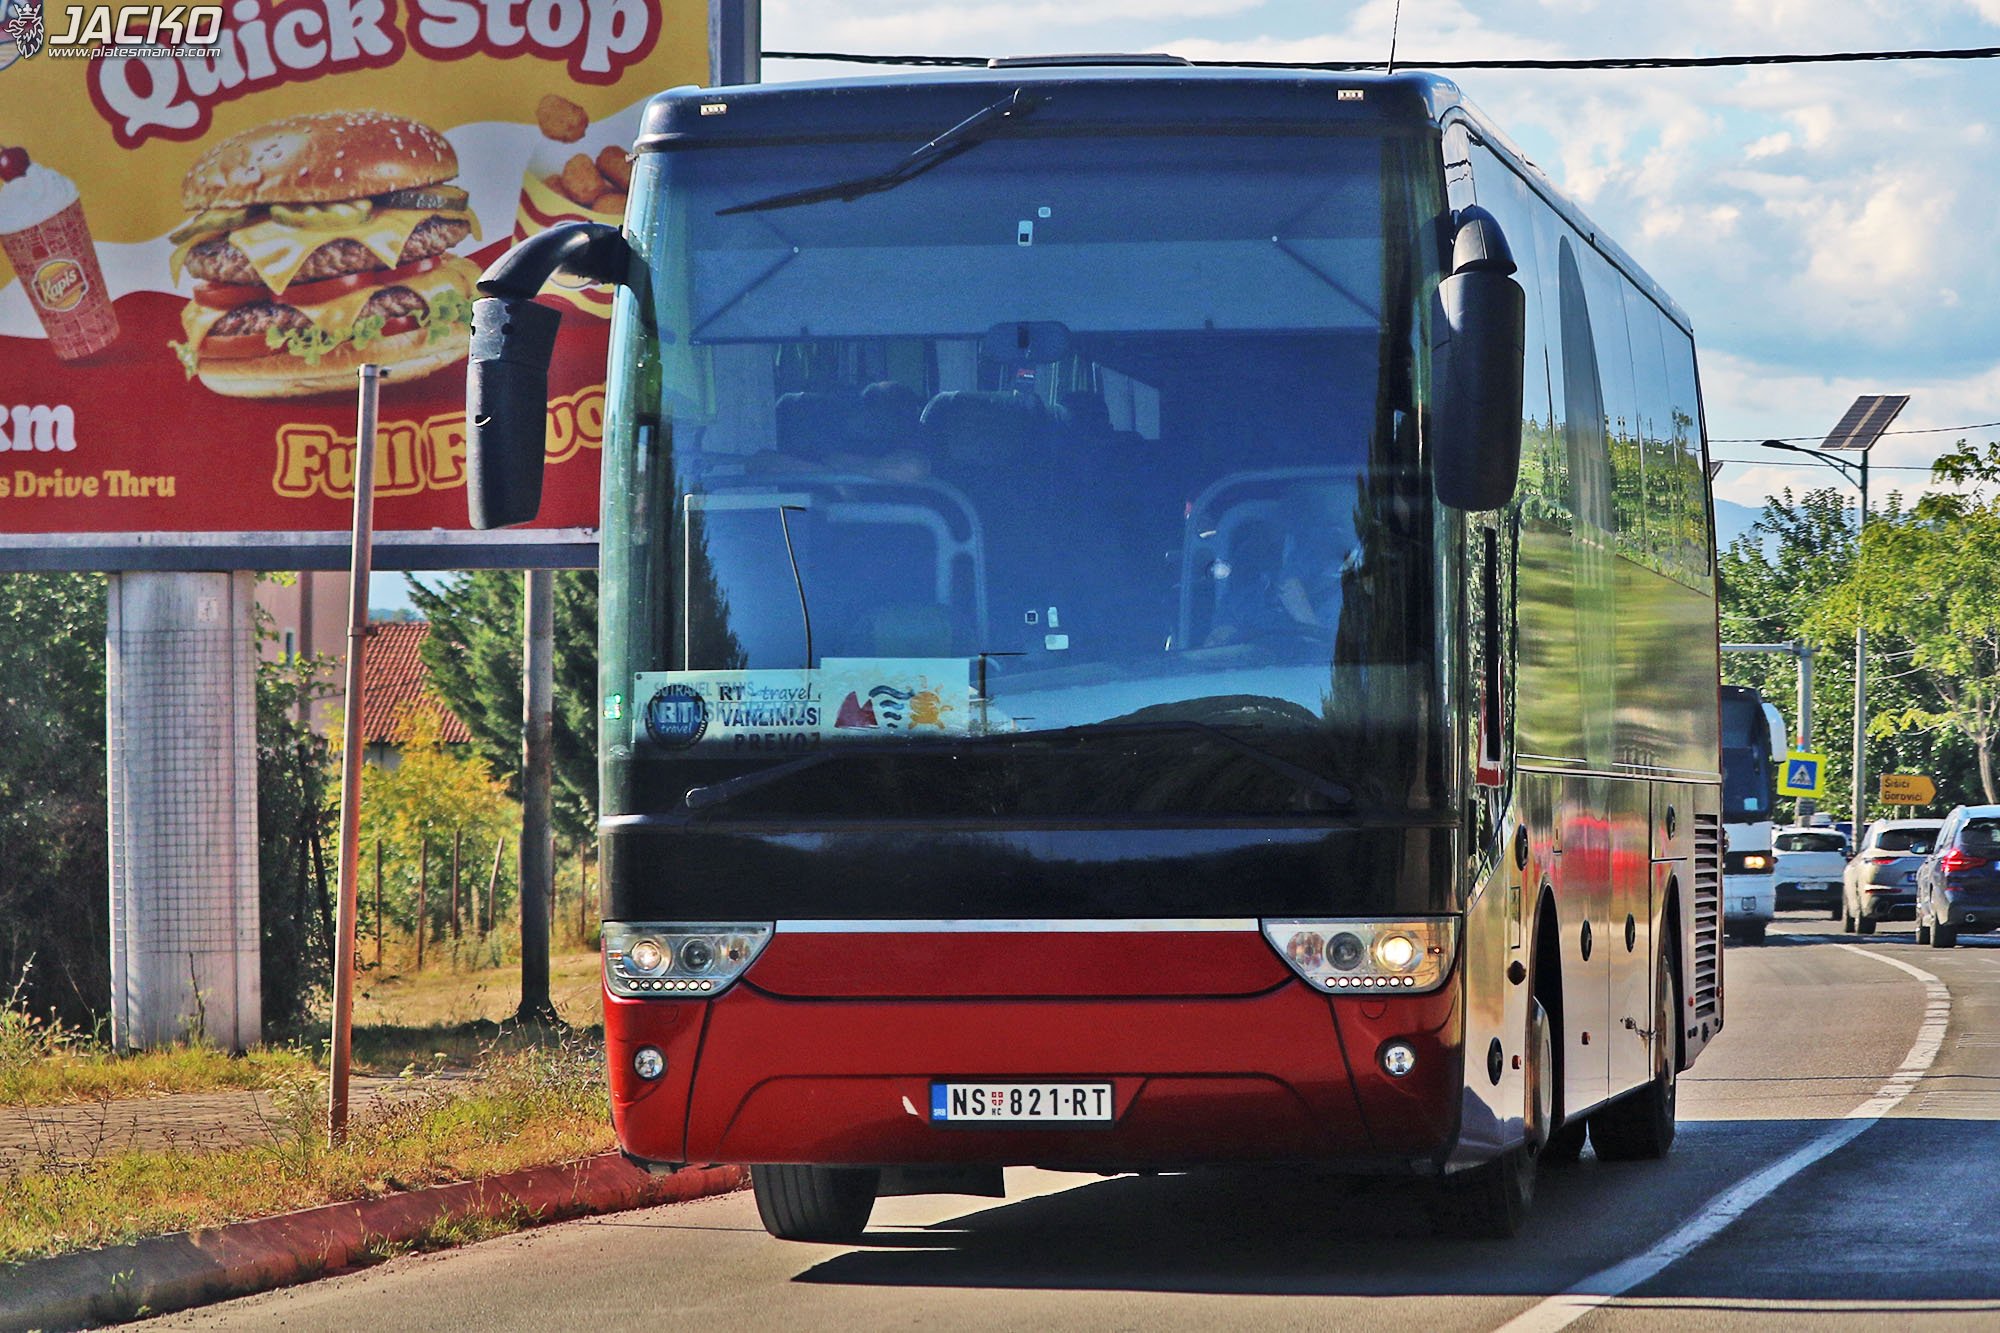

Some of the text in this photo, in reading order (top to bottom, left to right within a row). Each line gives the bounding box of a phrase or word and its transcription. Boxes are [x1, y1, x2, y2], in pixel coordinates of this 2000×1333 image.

[99, 0, 649, 137] Quick Stop
[278, 424, 421, 493] Full
[14, 468, 99, 497] Drive
[103, 469, 176, 497] Thru
[720, 685, 745, 700] RT
[953, 1088, 985, 1116] NS
